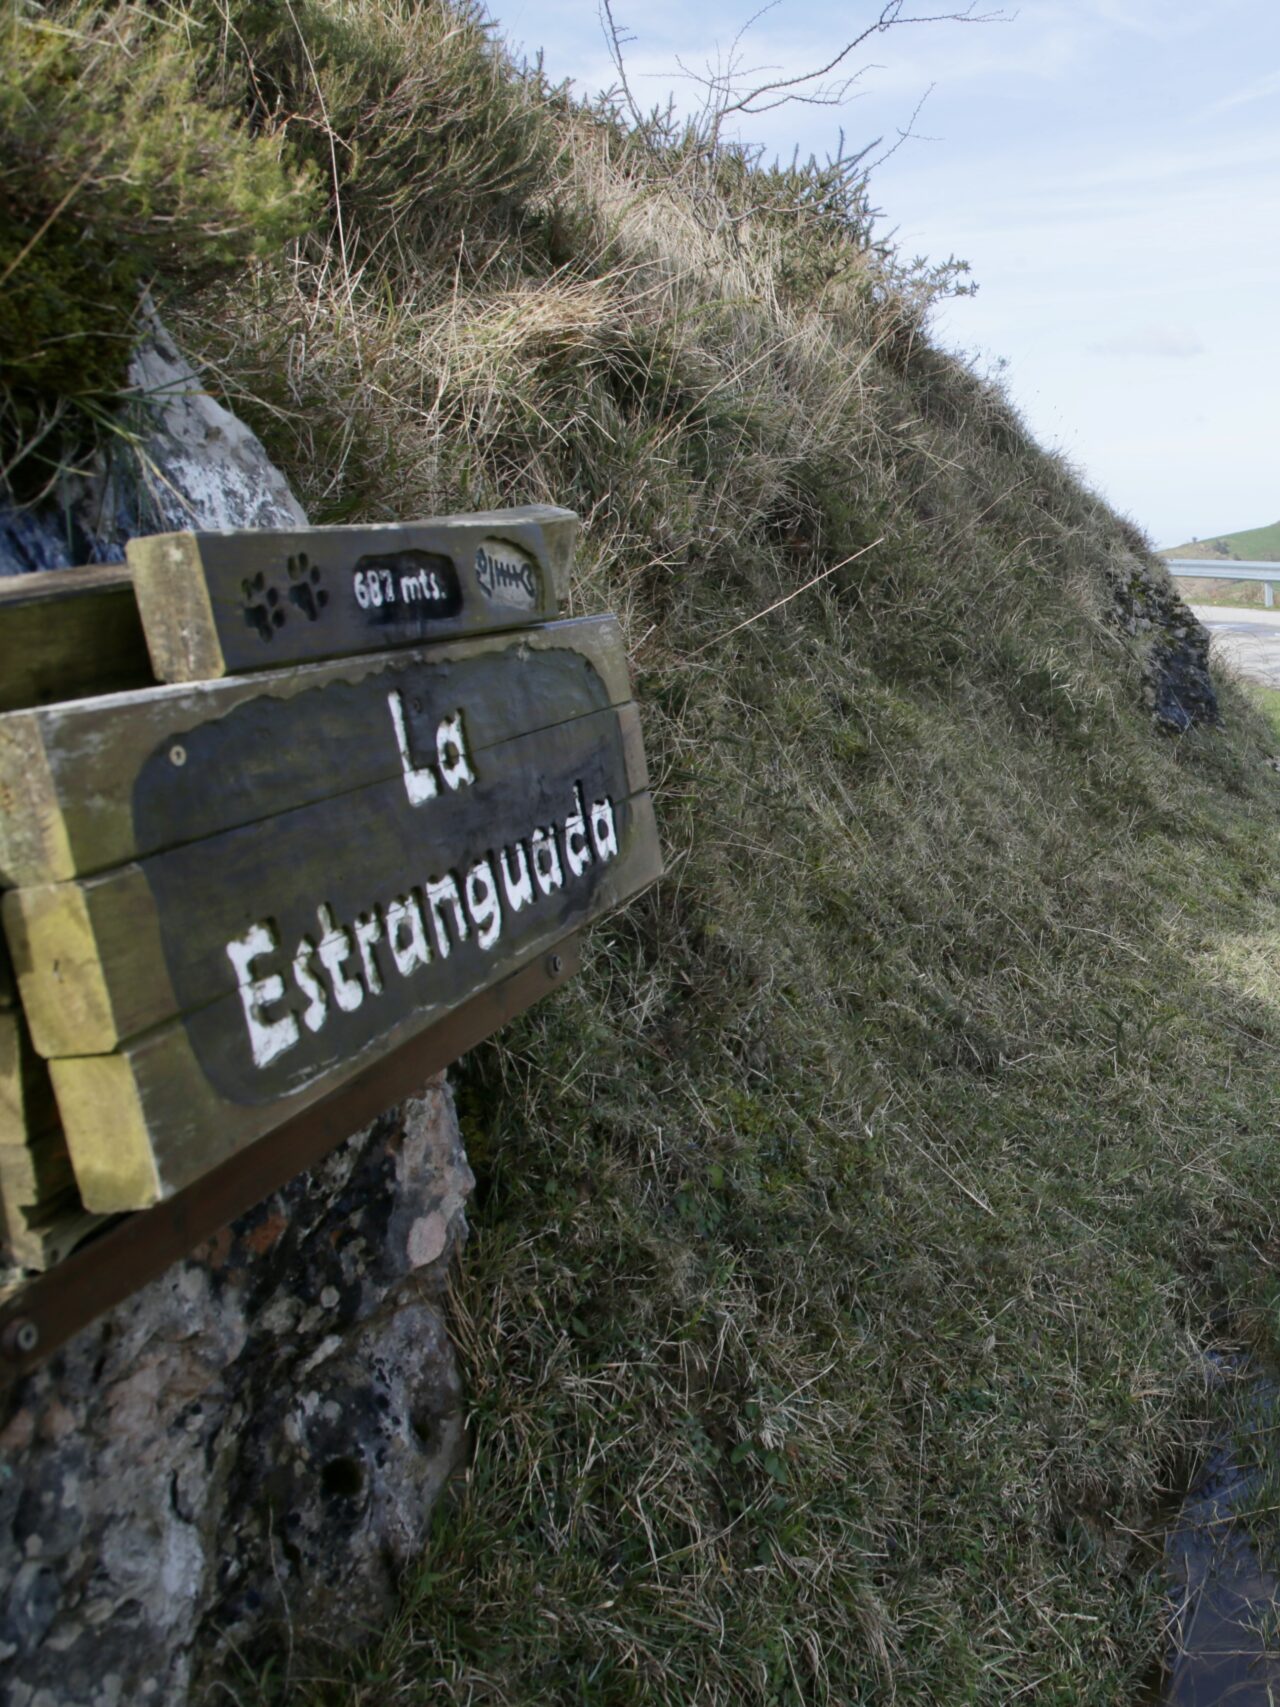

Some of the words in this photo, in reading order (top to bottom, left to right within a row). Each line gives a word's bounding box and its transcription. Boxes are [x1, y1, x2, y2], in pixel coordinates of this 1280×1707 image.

[400, 568, 447, 604] mts.
[387, 690, 474, 806] La
[226, 780, 619, 1068] Estranguada
